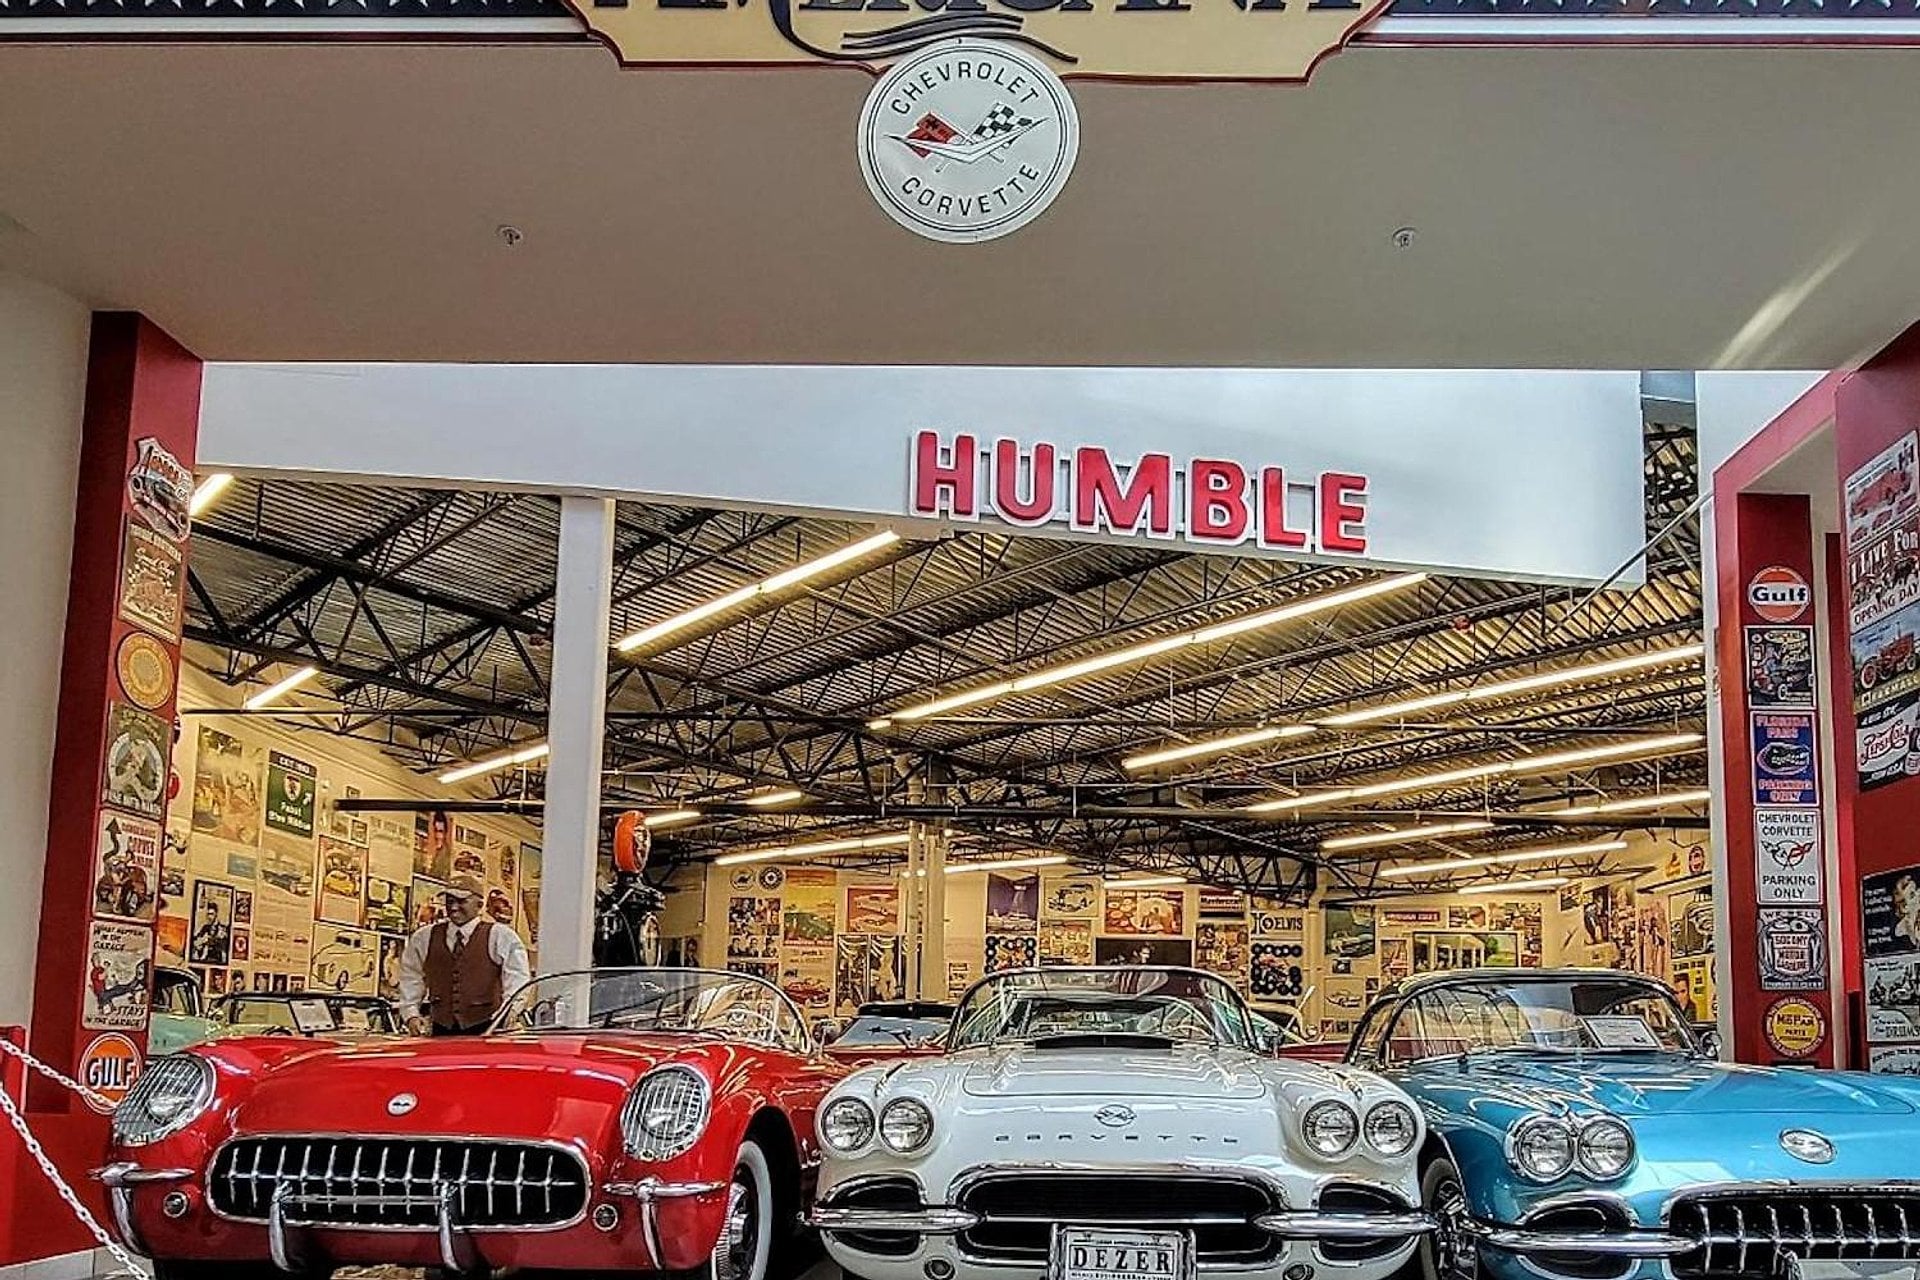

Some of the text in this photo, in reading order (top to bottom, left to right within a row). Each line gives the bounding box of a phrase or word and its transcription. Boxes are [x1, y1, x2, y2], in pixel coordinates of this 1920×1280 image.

[891, 61, 1039, 115] CHEVROLET
[902, 164, 1039, 216] CORVETTE
[913, 429, 1368, 553] HUMBLE
[1752, 586, 1808, 603] Gulf
[1758, 813, 1815, 824] CHEVROLET
[1762, 826, 1813, 837] CORVETTE
[1762, 875, 1816, 886] PARKING
[1774, 888, 1804, 899] ONLY
[87, 1056, 136, 1090] GULF
[995, 1134, 1238, 1144] CORVETTE
[1073, 1247, 1171, 1272] DEZER
